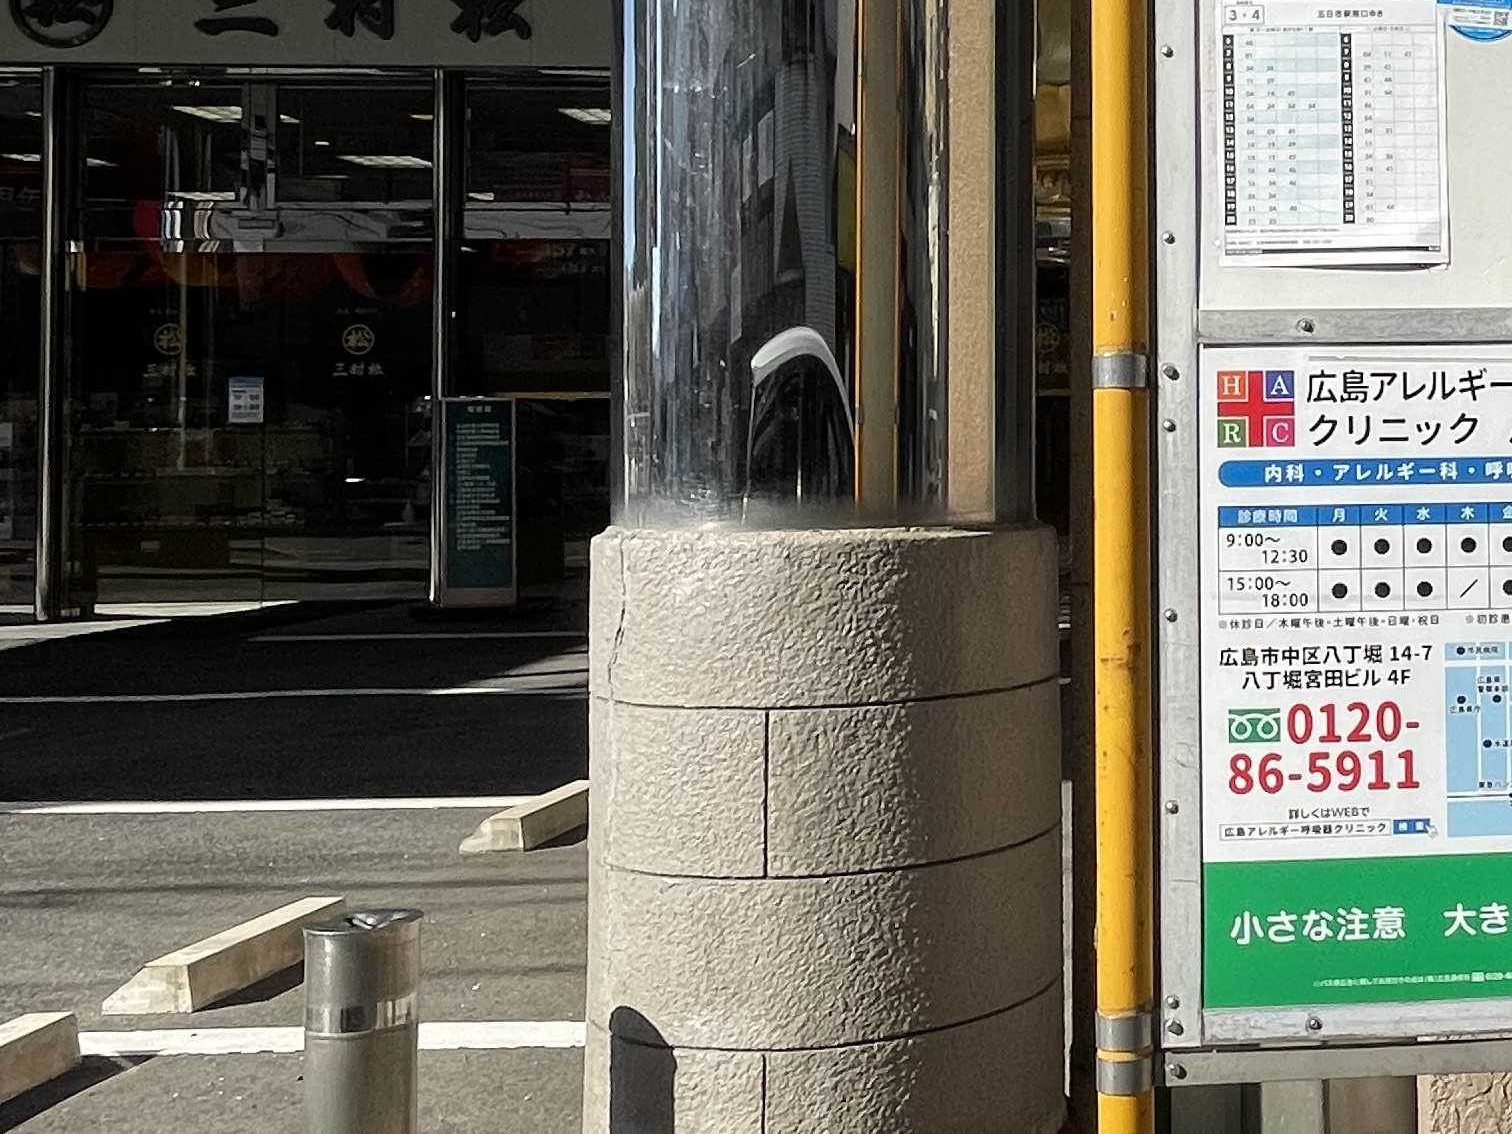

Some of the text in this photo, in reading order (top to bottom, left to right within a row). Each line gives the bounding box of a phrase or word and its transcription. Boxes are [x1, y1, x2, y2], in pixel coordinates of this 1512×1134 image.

[1222, 374, 1289, 395] H A
[1223, 422, 1289, 443] R C
[1309, 412, 1479, 446] クリニック
[1238, 509, 1298, 524] 診療時間
[1332, 508, 1346, 523] 月
[1374, 508, 1388, 522] 火
[1417, 507, 1431, 521] 水
[1461, 506, 1475, 519] 木
[1262, 549, 1308, 564] 12:30
[1262, 593, 1308, 608] 18:00
[1220, 644, 1433, 667] 広島市中区八丁堀 14-7
[1242, 668, 1411, 690] 八丁堀宮田ビル 4F
[1287, 701, 1420, 745] 0120-
[1229, 749, 1420, 795] 86-5911
[1225, 822, 1386, 837] 広島アレルギー呼吸器クリニック
[1229, 906, 1406, 946] 小さな注意
